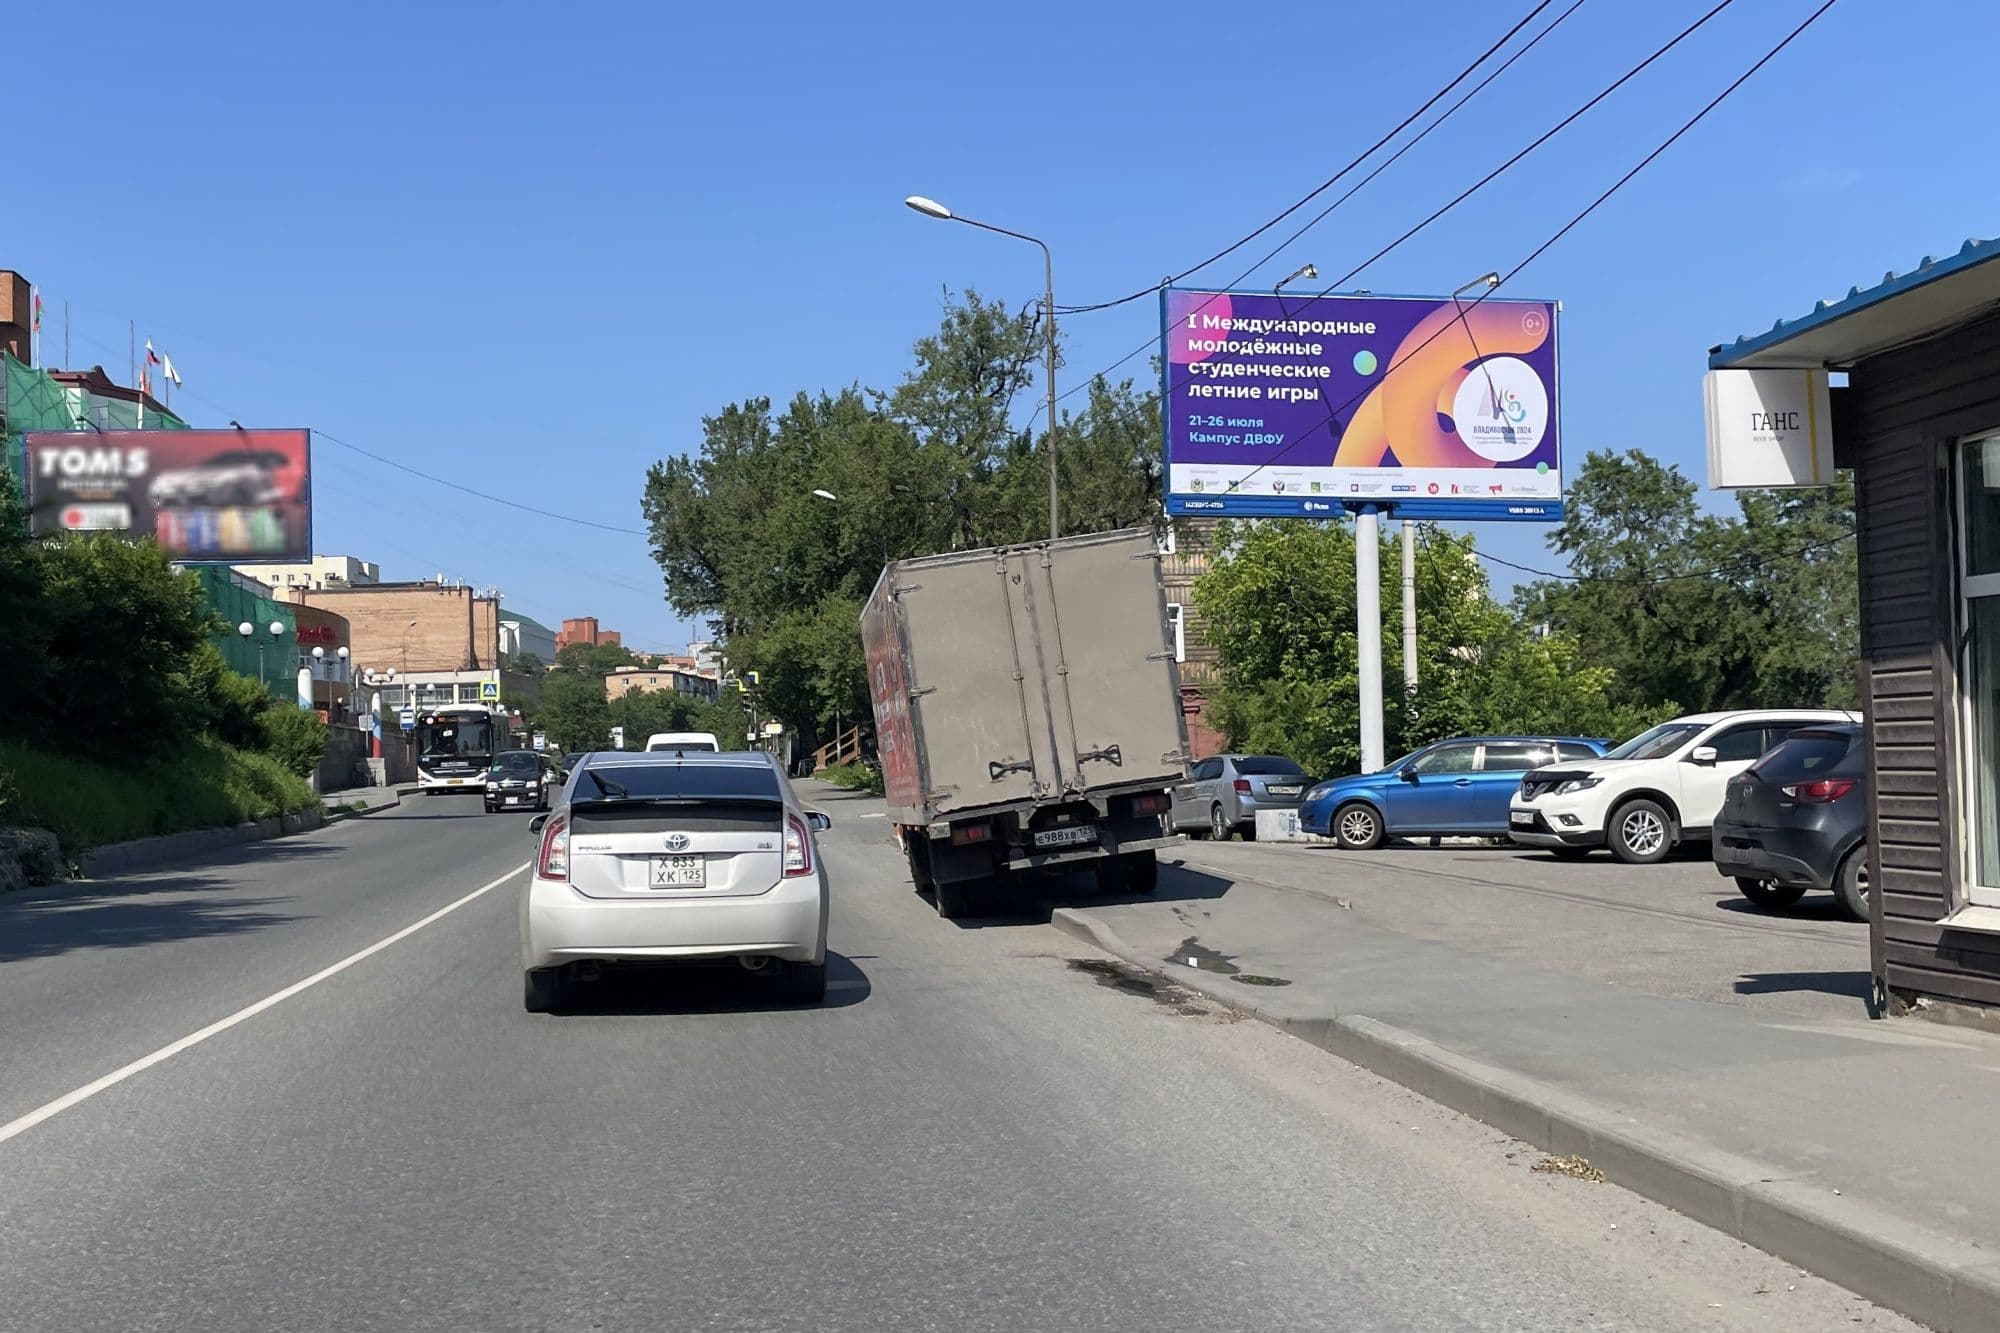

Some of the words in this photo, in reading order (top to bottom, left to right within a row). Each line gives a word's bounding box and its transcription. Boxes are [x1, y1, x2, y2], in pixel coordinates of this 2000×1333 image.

[1203, 314, 1376, 336] Международные
[1188, 338, 1323, 356] молодёжные
[1188, 361, 1331, 379] студенческие
[1188, 384, 1261, 399] летние
[1267, 387, 1319, 403] игры
[1227, 417, 1264, 428] июля
[1516, 425, 1532, 434] 2024
[1752, 412, 1800, 431] ГАНС
[1189, 431, 1240, 446] Кампус
[1243, 433, 1284, 446] ДВФУ
[672, 855, 696, 868] 833
[683, 870, 702, 880] 125
